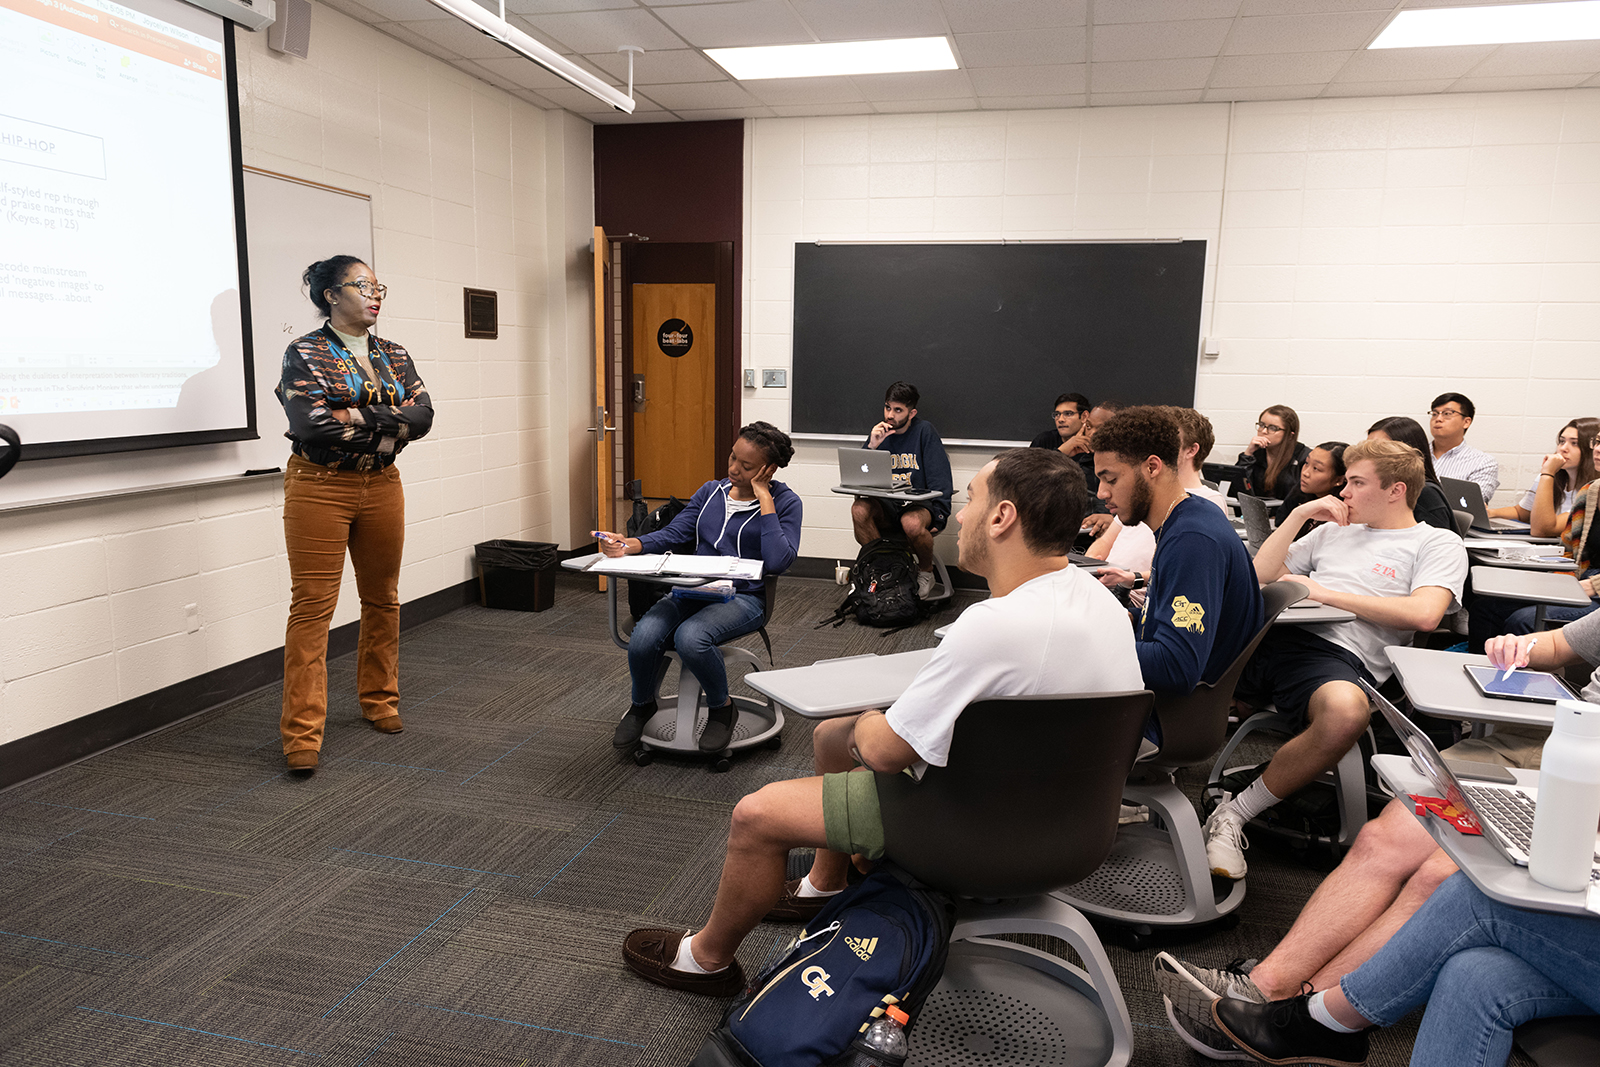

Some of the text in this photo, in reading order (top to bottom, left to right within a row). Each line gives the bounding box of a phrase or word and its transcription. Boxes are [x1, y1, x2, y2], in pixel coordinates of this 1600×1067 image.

[1, 132, 56, 153] HIP-HOP
[0, 181, 100, 210] lf-styled rep through
[11, 199, 41, 212] praise
[44, 204, 74, 216] names
[77, 208, 95, 220] that
[60, 217, 79, 232] 125)
[33, 265, 87, 278] mainstream
[94, 283, 104, 291] to
[19, 372, 30, 380] the
[32, 371, 60, 380] dualities
[61, 371, 70, 380] of
[70, 371, 113, 381] interpretation
[114, 371, 139, 379] between
[140, 370, 160, 380] literary
[51, 384, 65, 392] The
[1371, 562, 1396, 579] ZTA
[844, 936, 872, 962] adidas
